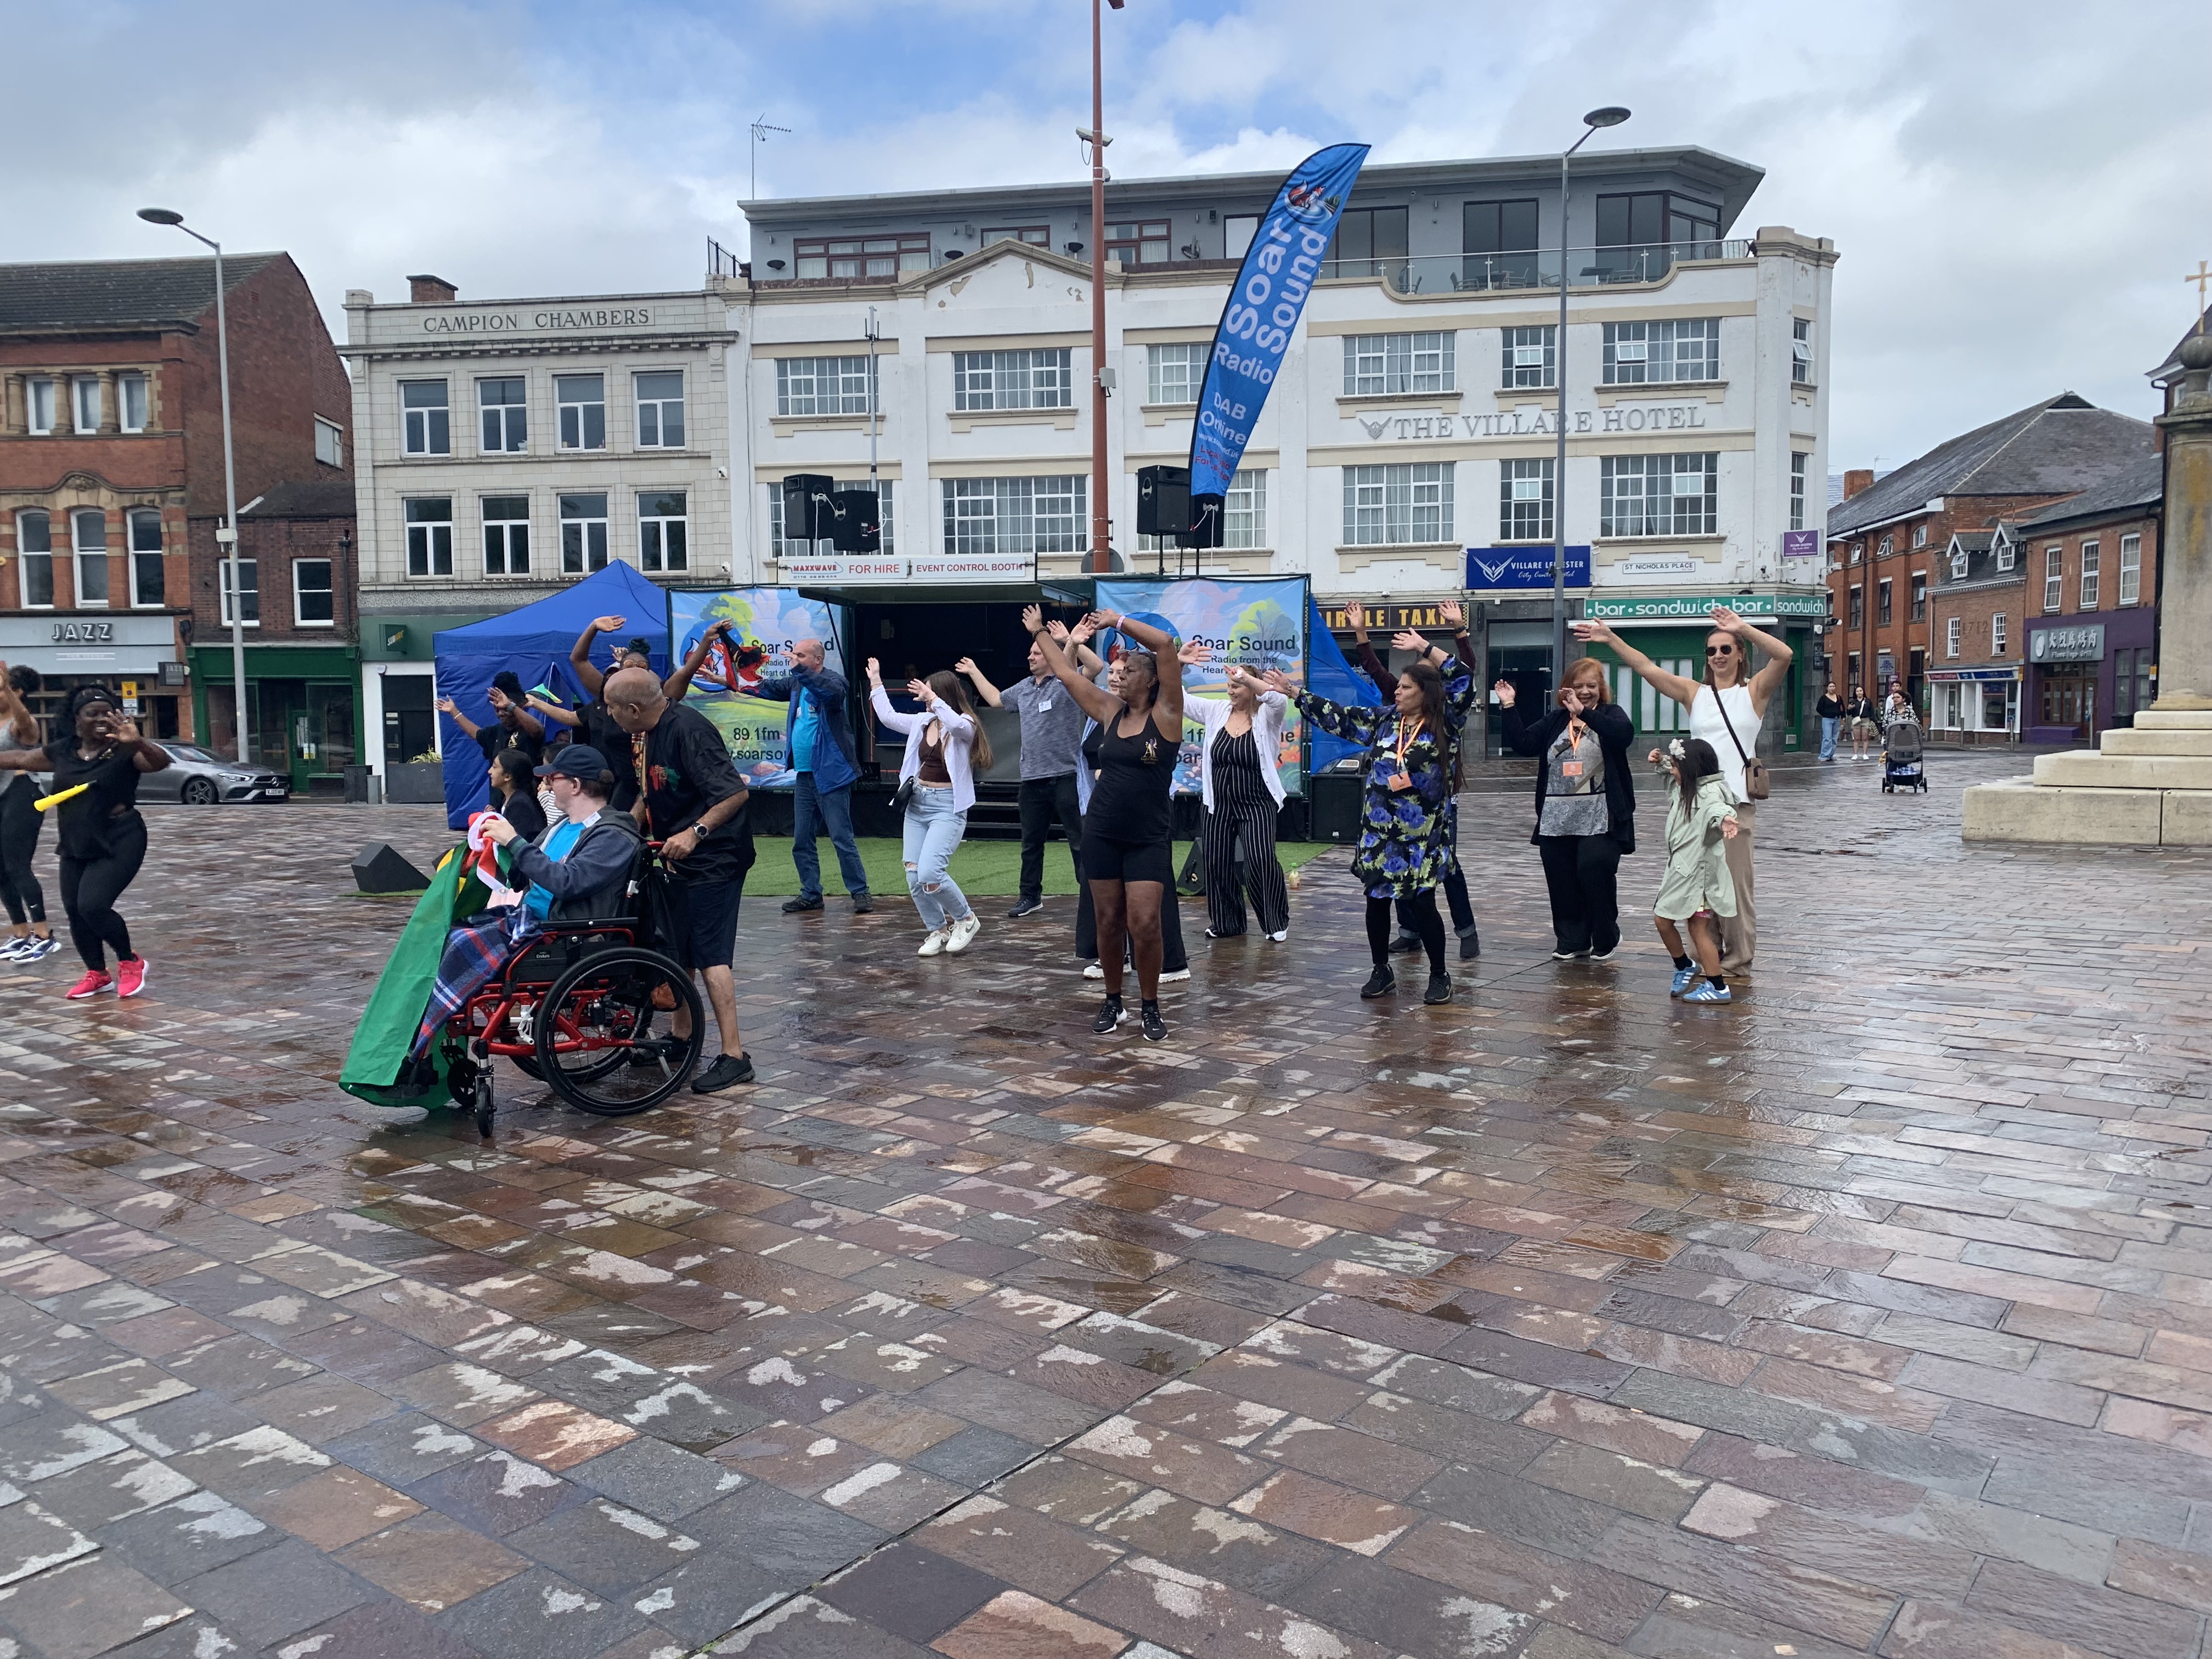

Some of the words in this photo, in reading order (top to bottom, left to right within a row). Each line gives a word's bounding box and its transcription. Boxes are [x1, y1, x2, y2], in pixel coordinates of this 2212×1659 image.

[1226, 217, 1292, 340] Soar
[1255, 225, 1328, 354] Sound
[424, 314, 517, 332] CAMPION
[535, 309, 649, 328] CHAMBERS
[1214, 341, 1273, 384] Radio
[1214, 391, 1246, 420] DAB
[1394, 417, 1453, 439] THE
[1602, 407, 1706, 432] HOTEL
[849, 565, 871, 574] FOR
[874, 564, 900, 573] HIRE
[991, 563, 1023, 571] BOOTH
[1518, 571, 1533, 582] City
[1595, 602, 1623, 616] bar
[1635, 599, 1723, 615] sandwich
[1732, 599, 1762, 613] bar
[1777, 599, 1824, 614] sandwich
[1319, 610, 1386, 628] IRLE
[1399, 607, 1454, 626] TAXI
[52, 623, 112, 641] JAZZ
[1239, 634, 1295, 651] Sound
[1211, 655, 1237, 664] Radio
[1239, 655, 1260, 664] from
[1263, 655, 1277, 664] the
[733, 727, 781, 741] 89.1fm
